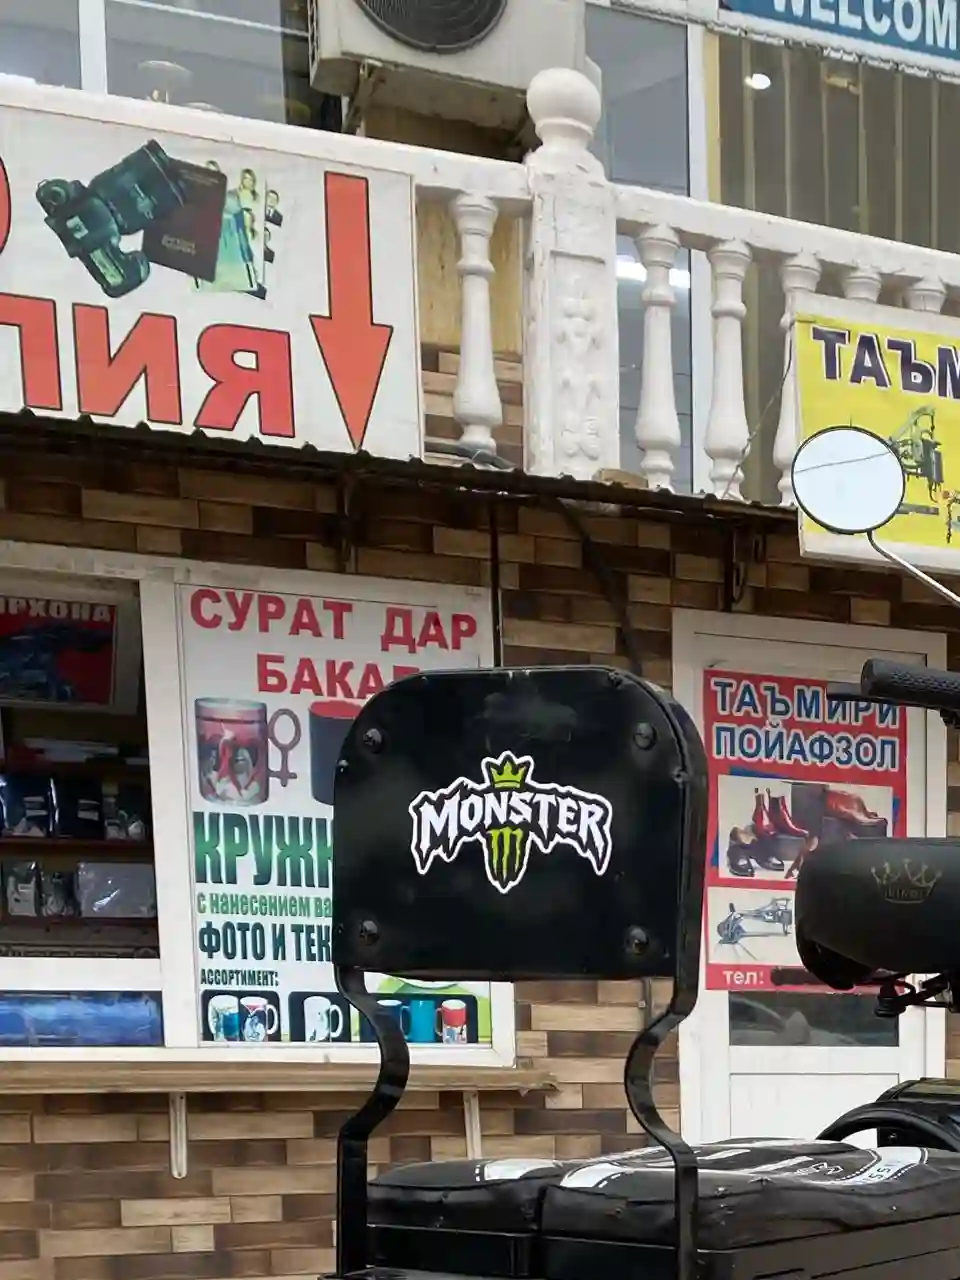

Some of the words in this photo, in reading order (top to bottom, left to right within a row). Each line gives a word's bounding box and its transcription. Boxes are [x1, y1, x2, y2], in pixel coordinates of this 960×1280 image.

[0, 596, 111, 622] РХОНА
[189, 588, 353, 640] СУРАТ
[380, 606, 478, 654] ДАР
[712, 680, 898, 728] ТАЪМИРИ
[714, 719, 898, 769] ПОЙАФЗОЛ
[418, 788, 606, 861] MONSTER
[198, 921, 266, 960] ФОТО
[271, 923, 286, 961] И
